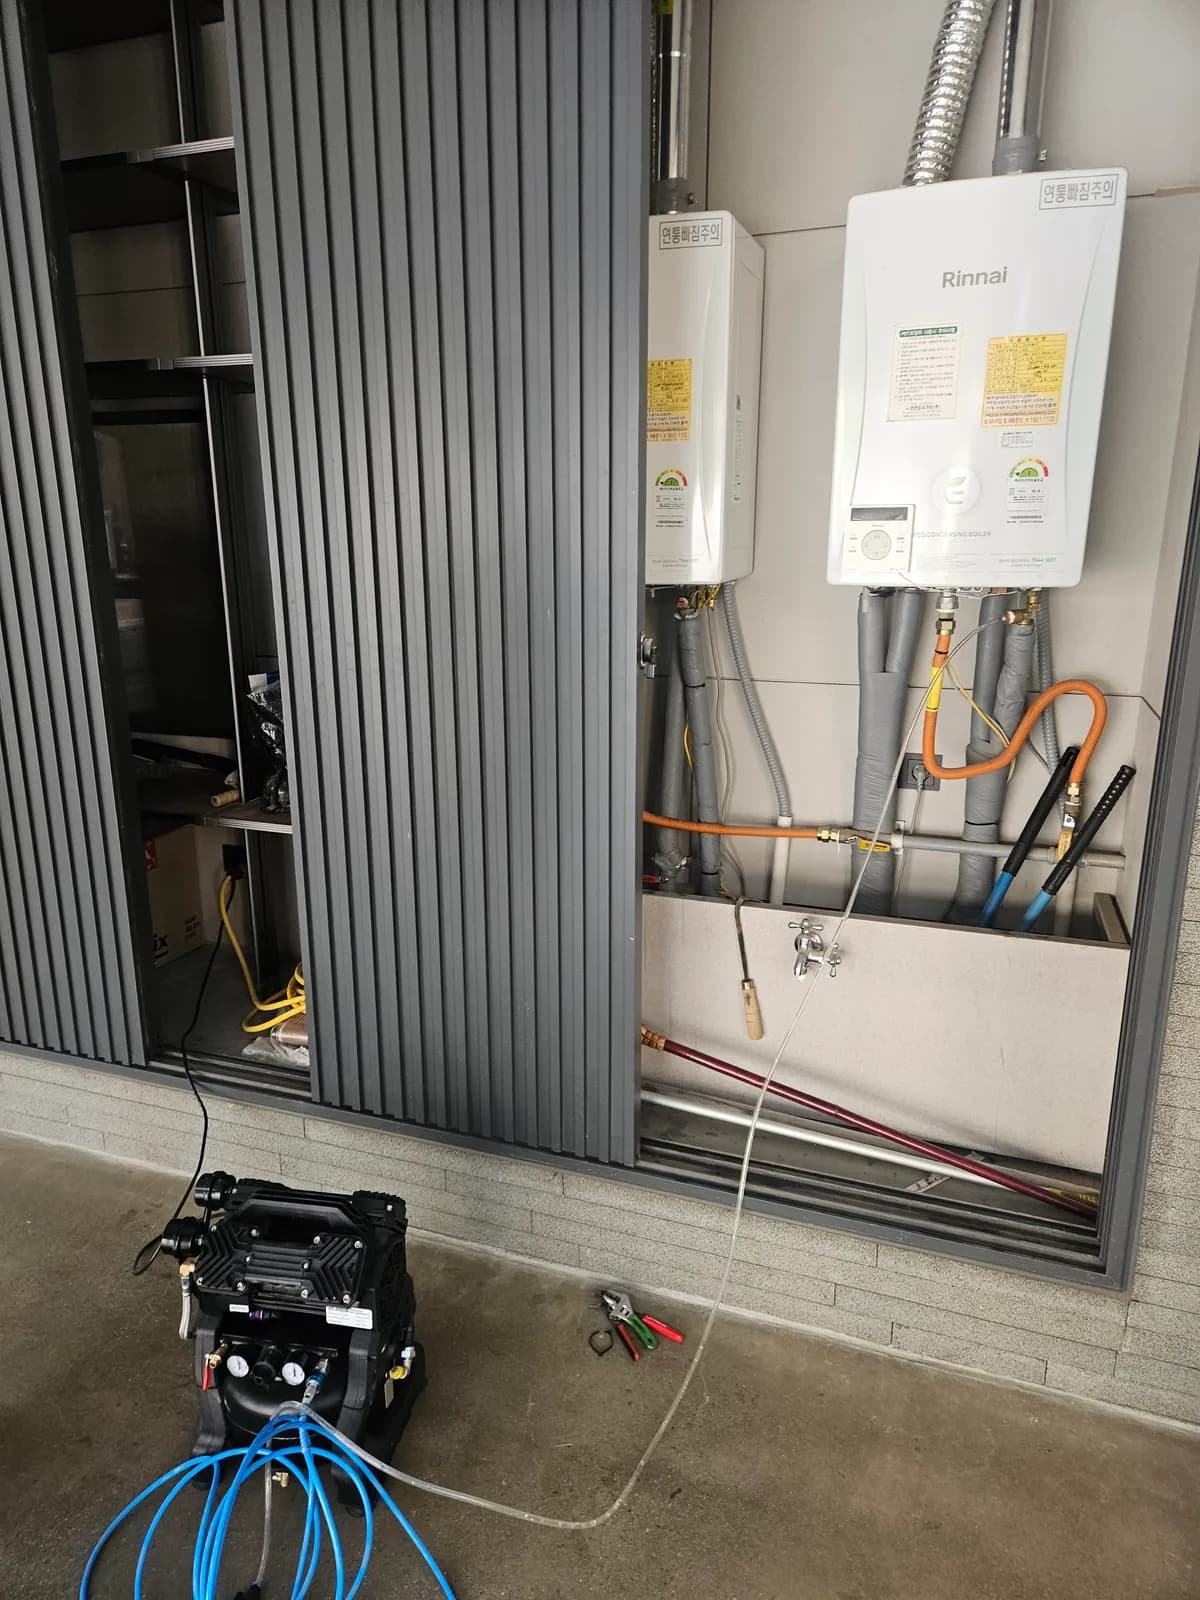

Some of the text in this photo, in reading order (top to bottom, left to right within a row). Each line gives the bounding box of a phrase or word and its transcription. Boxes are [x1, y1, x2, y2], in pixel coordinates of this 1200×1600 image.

[1043, 181, 1113, 203] 연통빠짐주의
[663, 224, 719, 243] 연통빠짐주의
[942, 267, 1007, 287] Rinnai
[152, 933, 169, 951] ix
